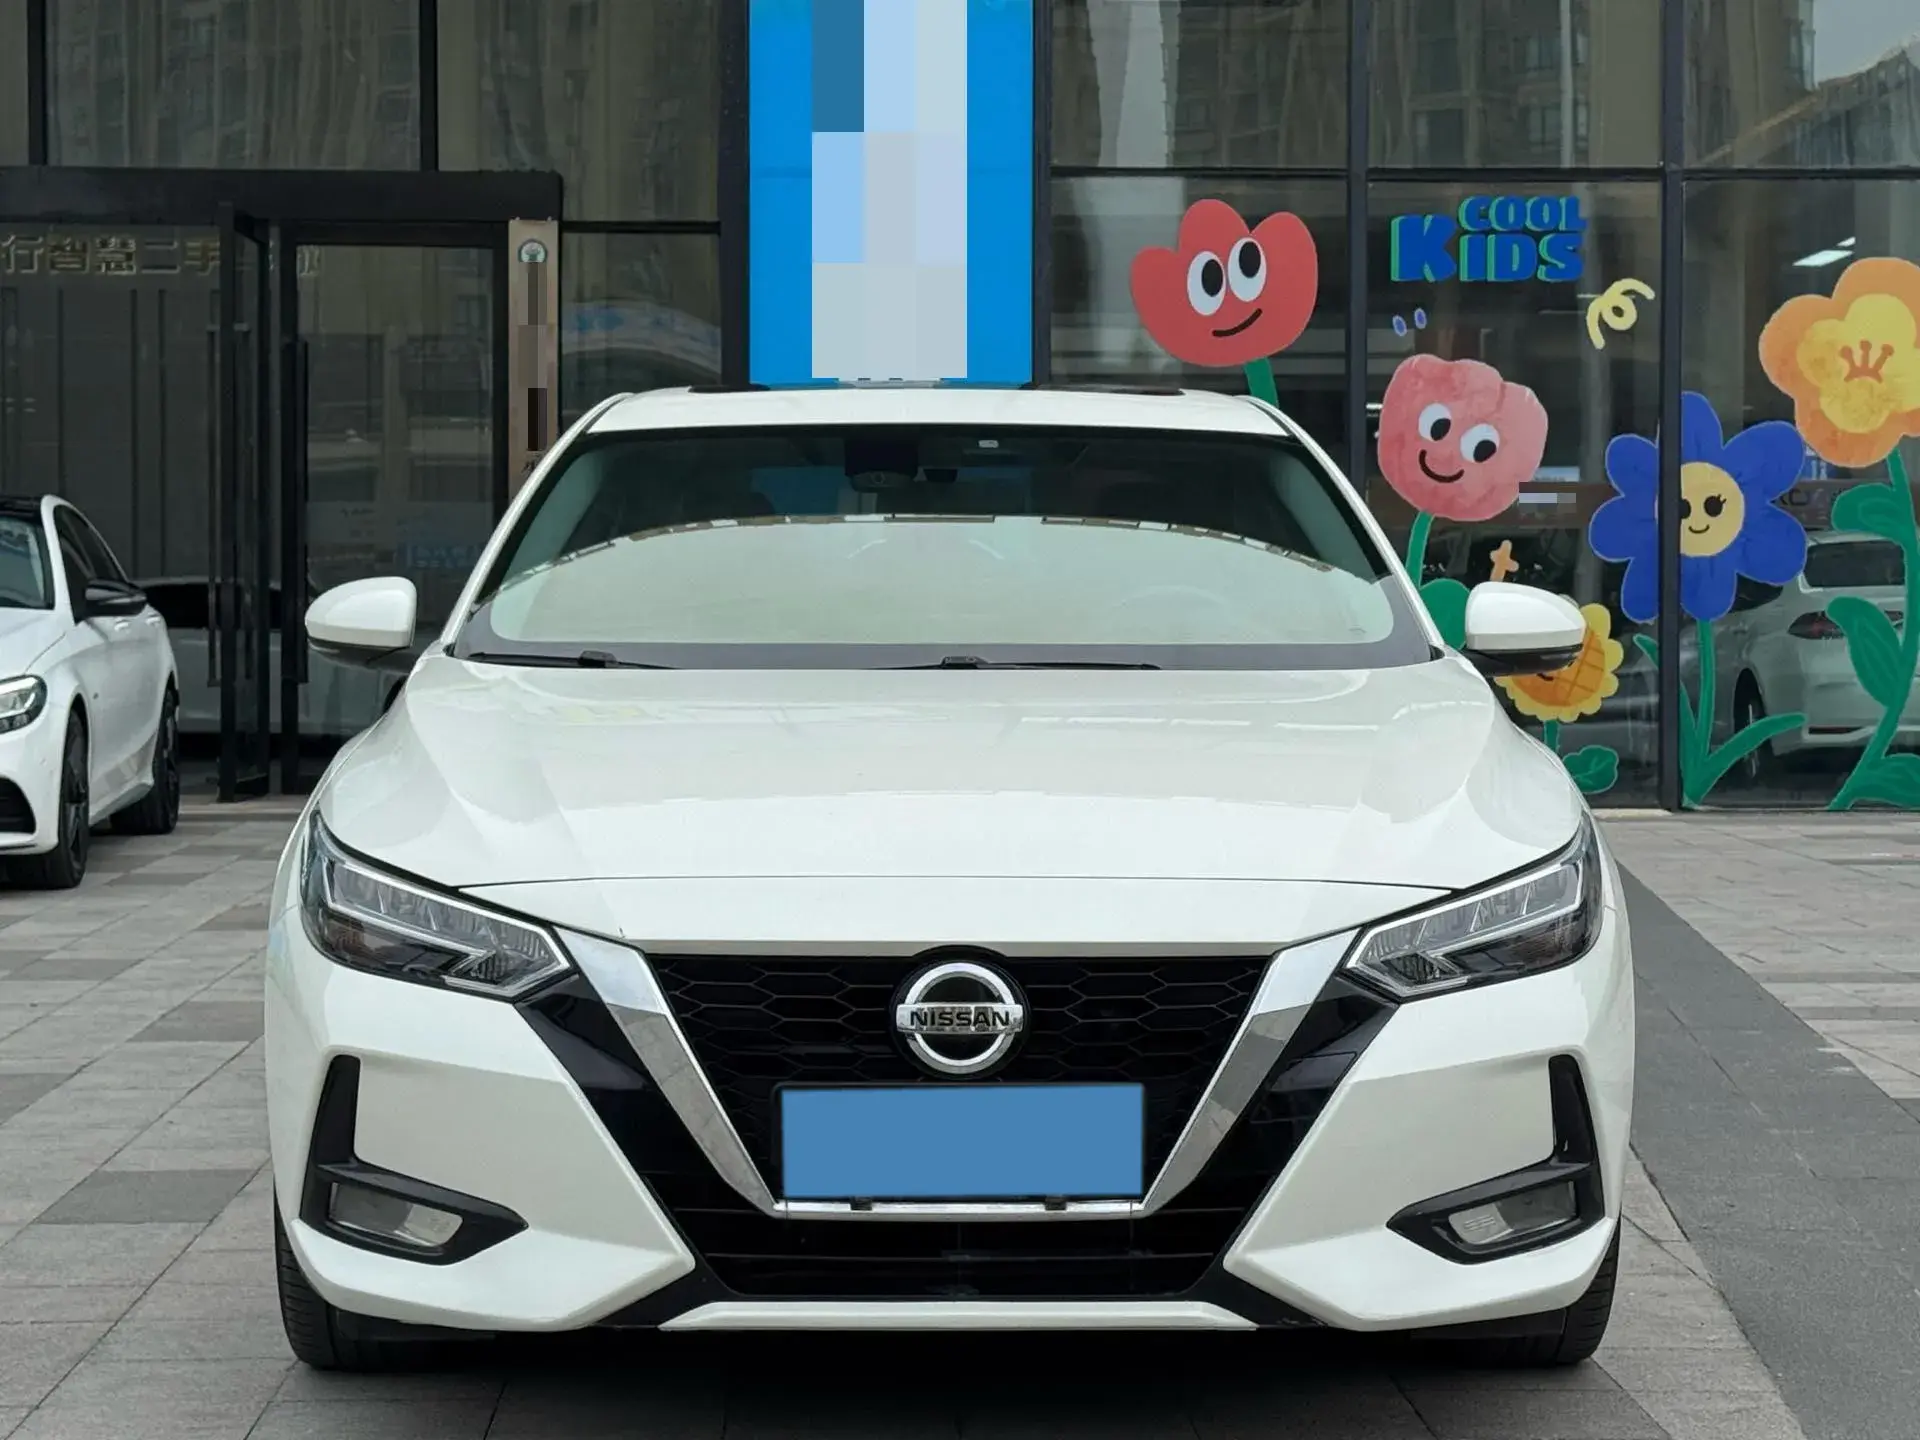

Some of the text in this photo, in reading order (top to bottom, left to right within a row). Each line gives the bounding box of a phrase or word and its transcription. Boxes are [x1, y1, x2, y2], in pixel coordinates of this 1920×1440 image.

[1458, 195, 1587, 231] COOL
[1, 234, 320, 276] 行智慧二手
[1390, 213, 1584, 283] KIDS
[909, 1010, 1010, 1027] NISSAN
